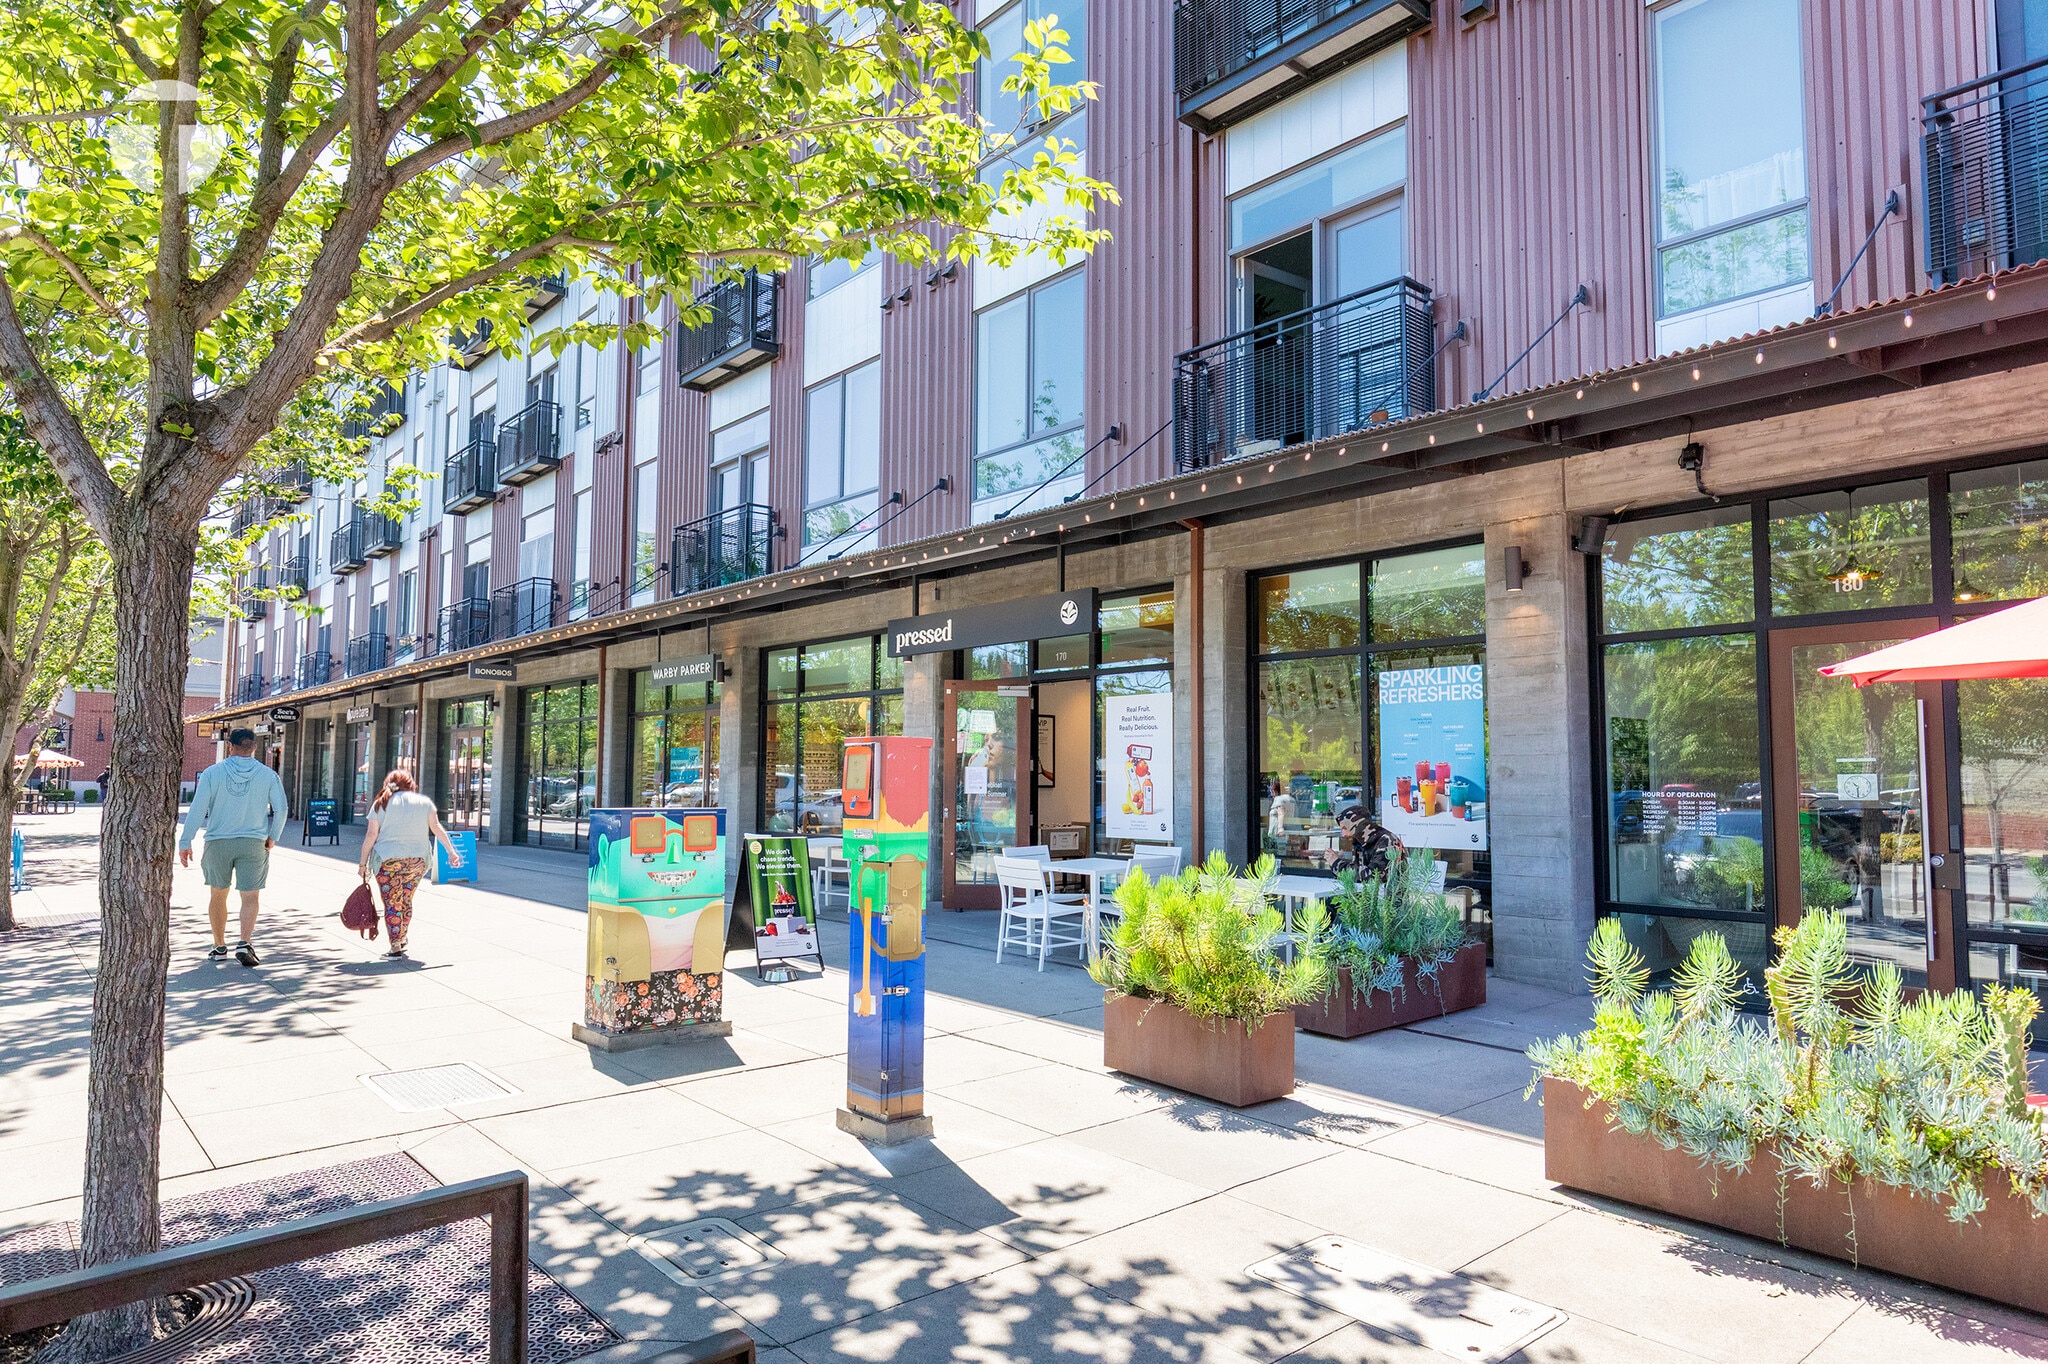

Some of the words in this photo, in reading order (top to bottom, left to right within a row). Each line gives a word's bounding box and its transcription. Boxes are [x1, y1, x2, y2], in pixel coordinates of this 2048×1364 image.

[1832, 577, 1863, 592] 180
[896, 618, 952, 653] pressed
[1056, 652, 1067, 661] 170
[475, 668, 512, 676] BONOBOS
[653, 667, 678, 679] WARBY
[680, 662, 710, 676] PARKER
[1380, 665, 1482, 688] SPARKLING
[1380, 684, 1483, 704] REFRESHERS
[774, 906, 795, 915] pressed
